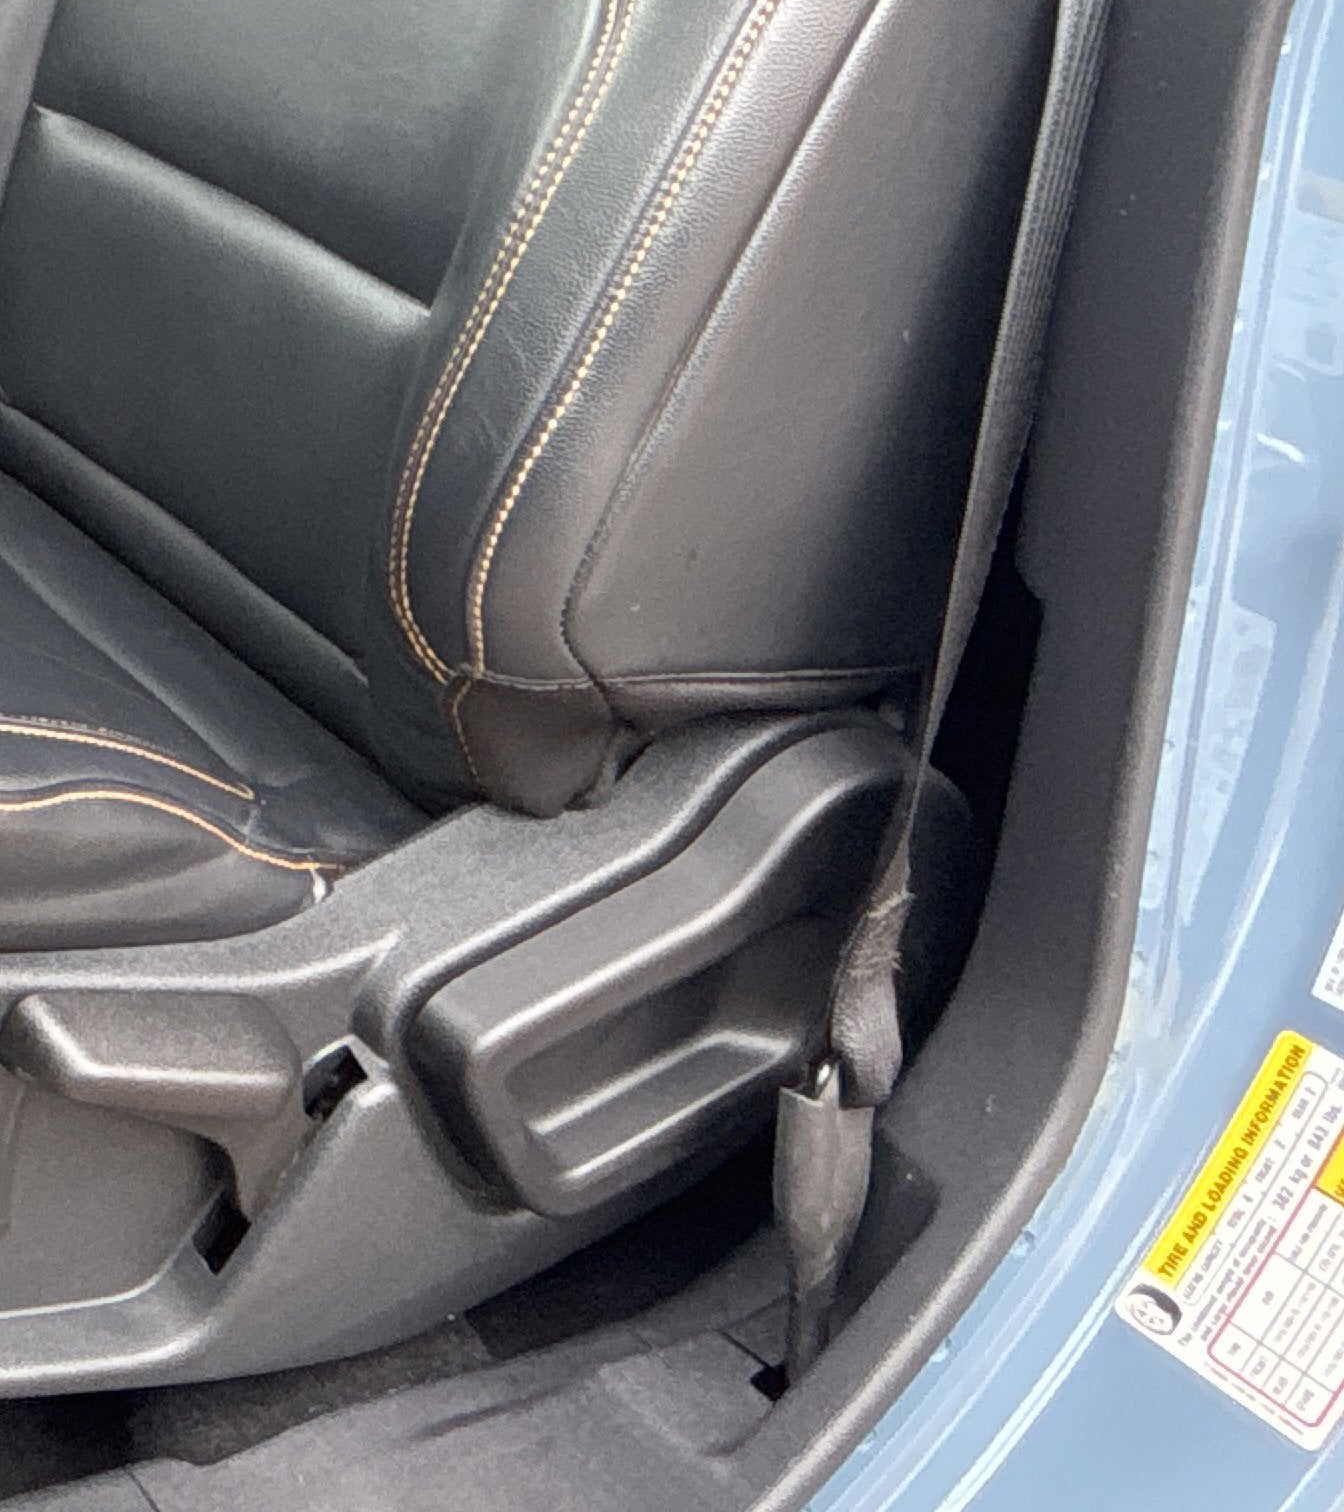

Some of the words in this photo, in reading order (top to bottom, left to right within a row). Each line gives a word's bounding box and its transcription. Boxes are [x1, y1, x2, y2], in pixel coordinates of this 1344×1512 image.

[1157, 1242, 1189, 1278] TIRE
[1182, 1210, 1208, 1246] AND
[1200, 1146, 1249, 1212] LOADING
[1240, 1043, 1306, 1146] INFORMATION
